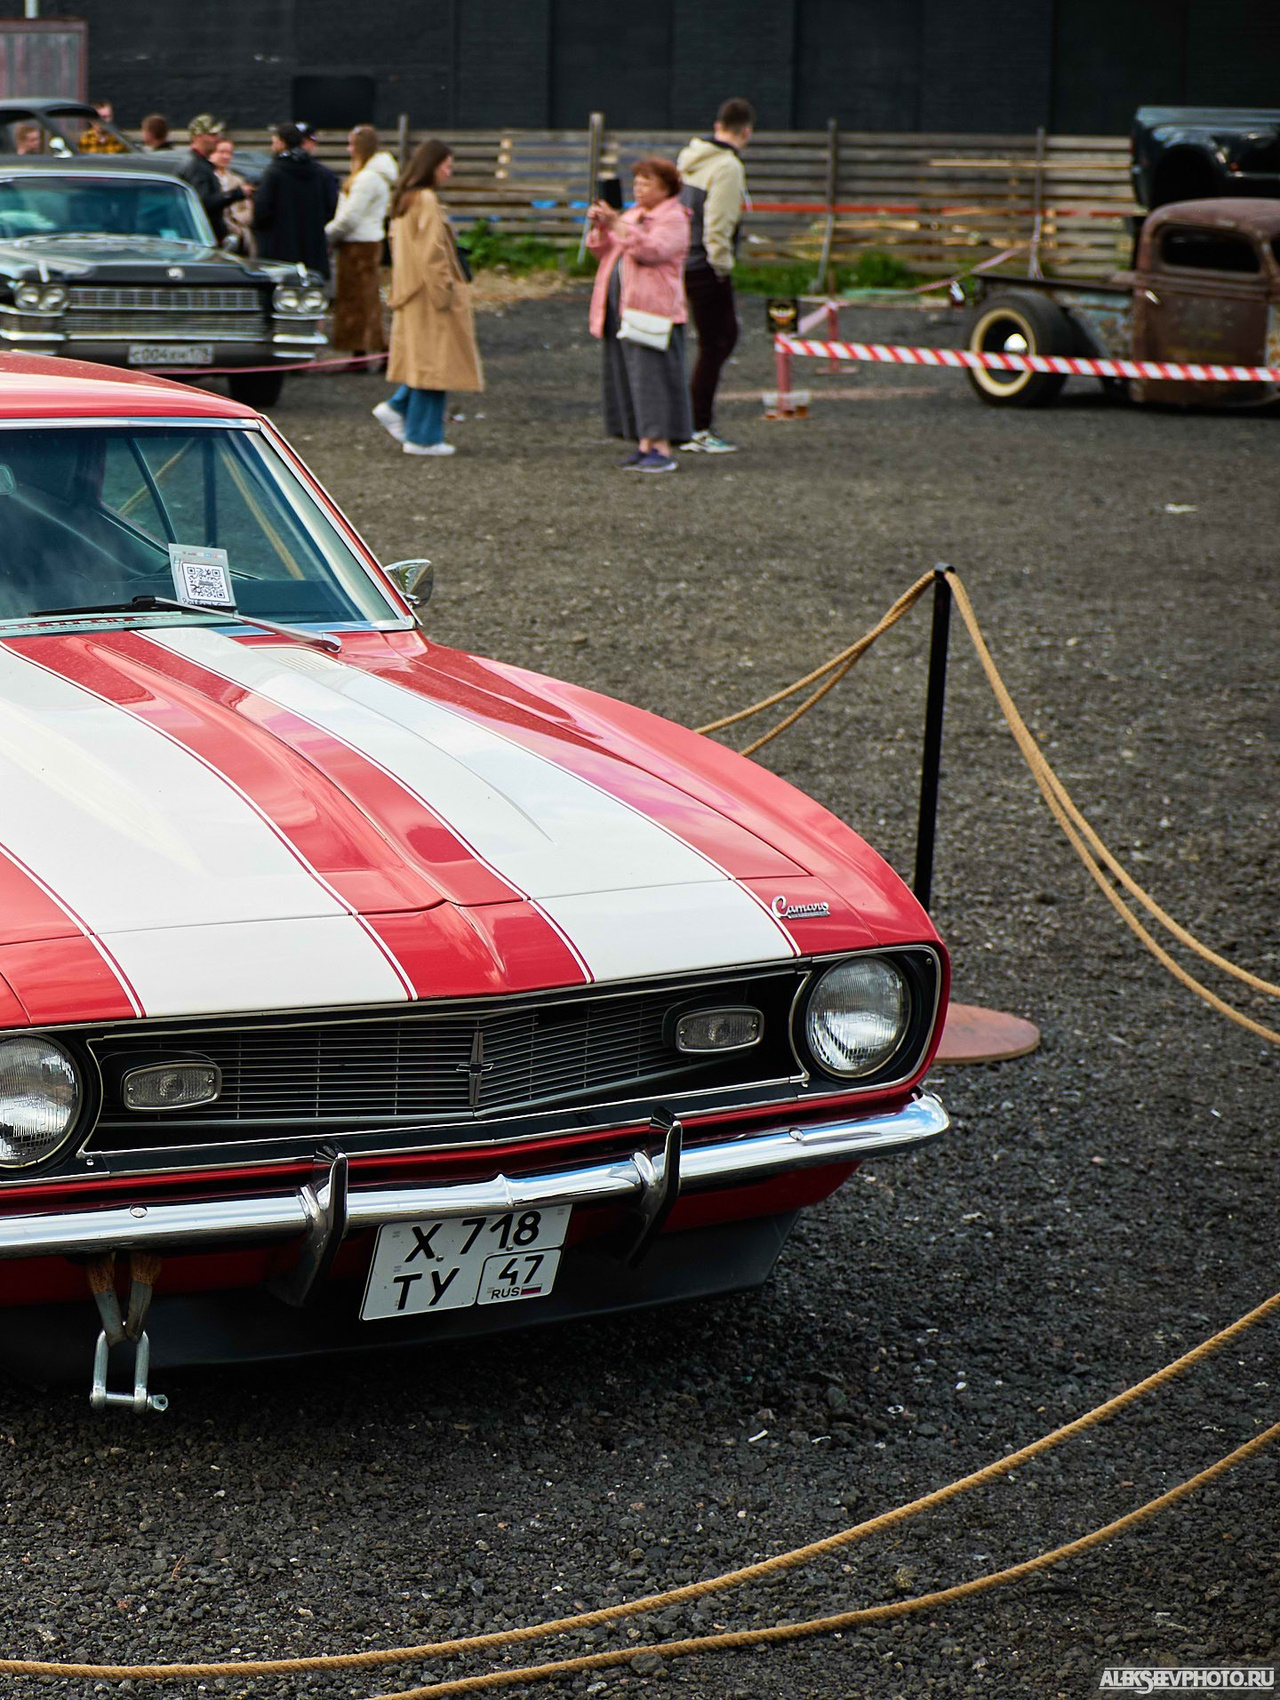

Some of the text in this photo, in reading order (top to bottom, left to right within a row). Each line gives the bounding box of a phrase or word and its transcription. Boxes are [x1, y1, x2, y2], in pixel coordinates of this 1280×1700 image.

[771, 895, 830, 919] Camaro
[459, 1210, 542, 1255] 718
[498, 1254, 545, 1286] 47
[393, 1267, 460, 1311] TY
[491, 1286, 520, 1300] RUS
